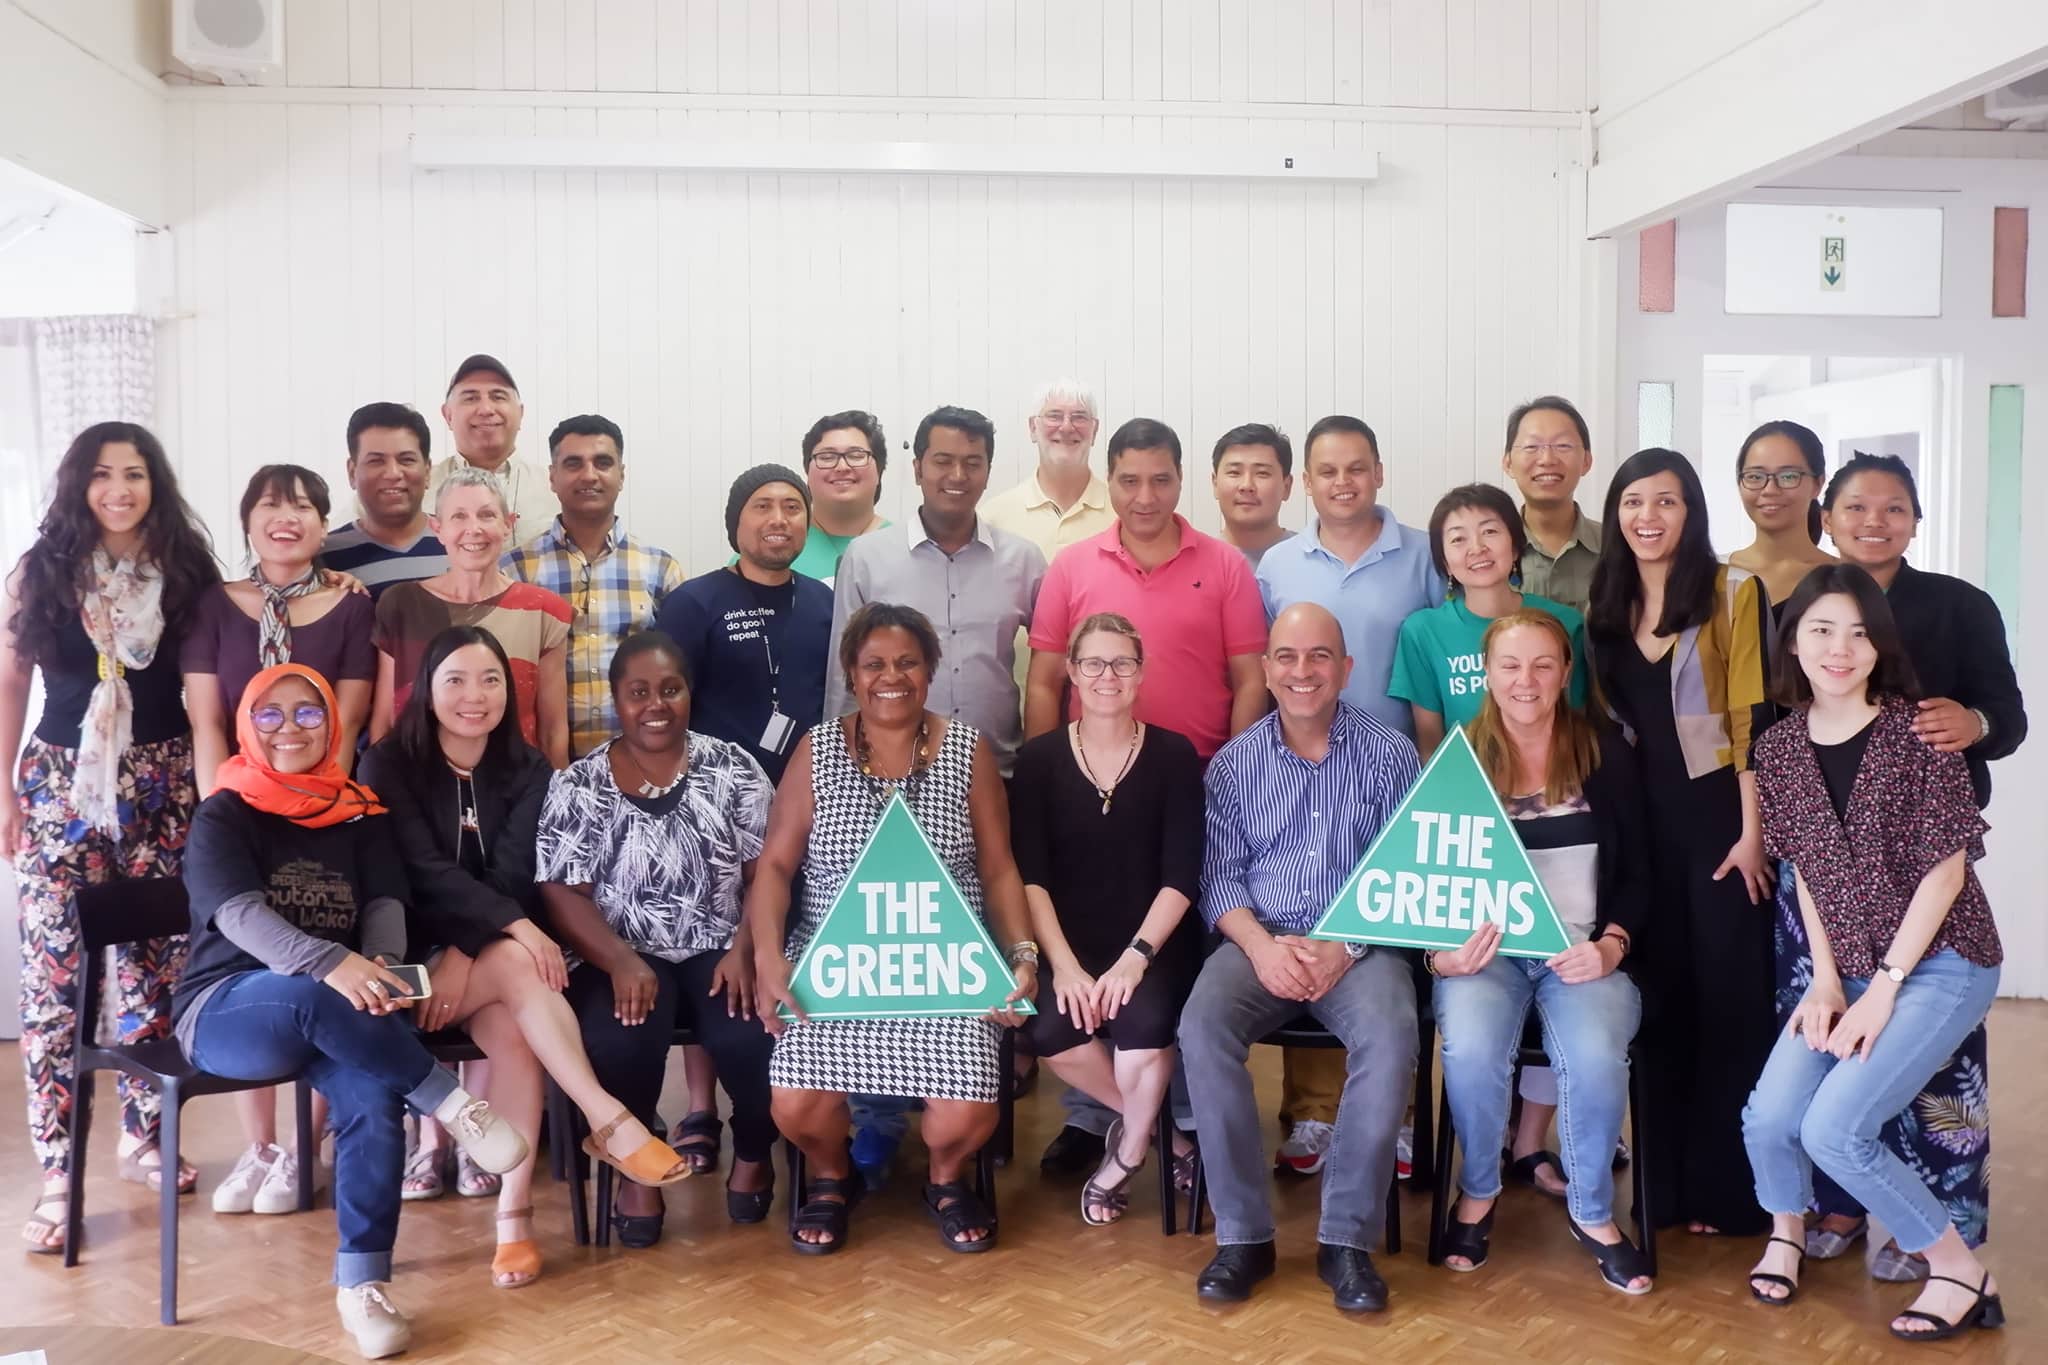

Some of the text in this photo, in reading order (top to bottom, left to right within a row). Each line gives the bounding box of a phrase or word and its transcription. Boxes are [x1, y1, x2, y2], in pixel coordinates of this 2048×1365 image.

[724, 609, 747, 620] drink
[726, 621, 740, 630] do
[729, 630, 760, 642] repeat
[1446, 653, 1486, 674] YOU
[1449, 677, 1467, 696] IS
[1411, 811, 1496, 870] THE
[857, 881, 942, 935] THE
[1357, 868, 1535, 936] GREENS
[810, 942, 987, 999] GREENS
